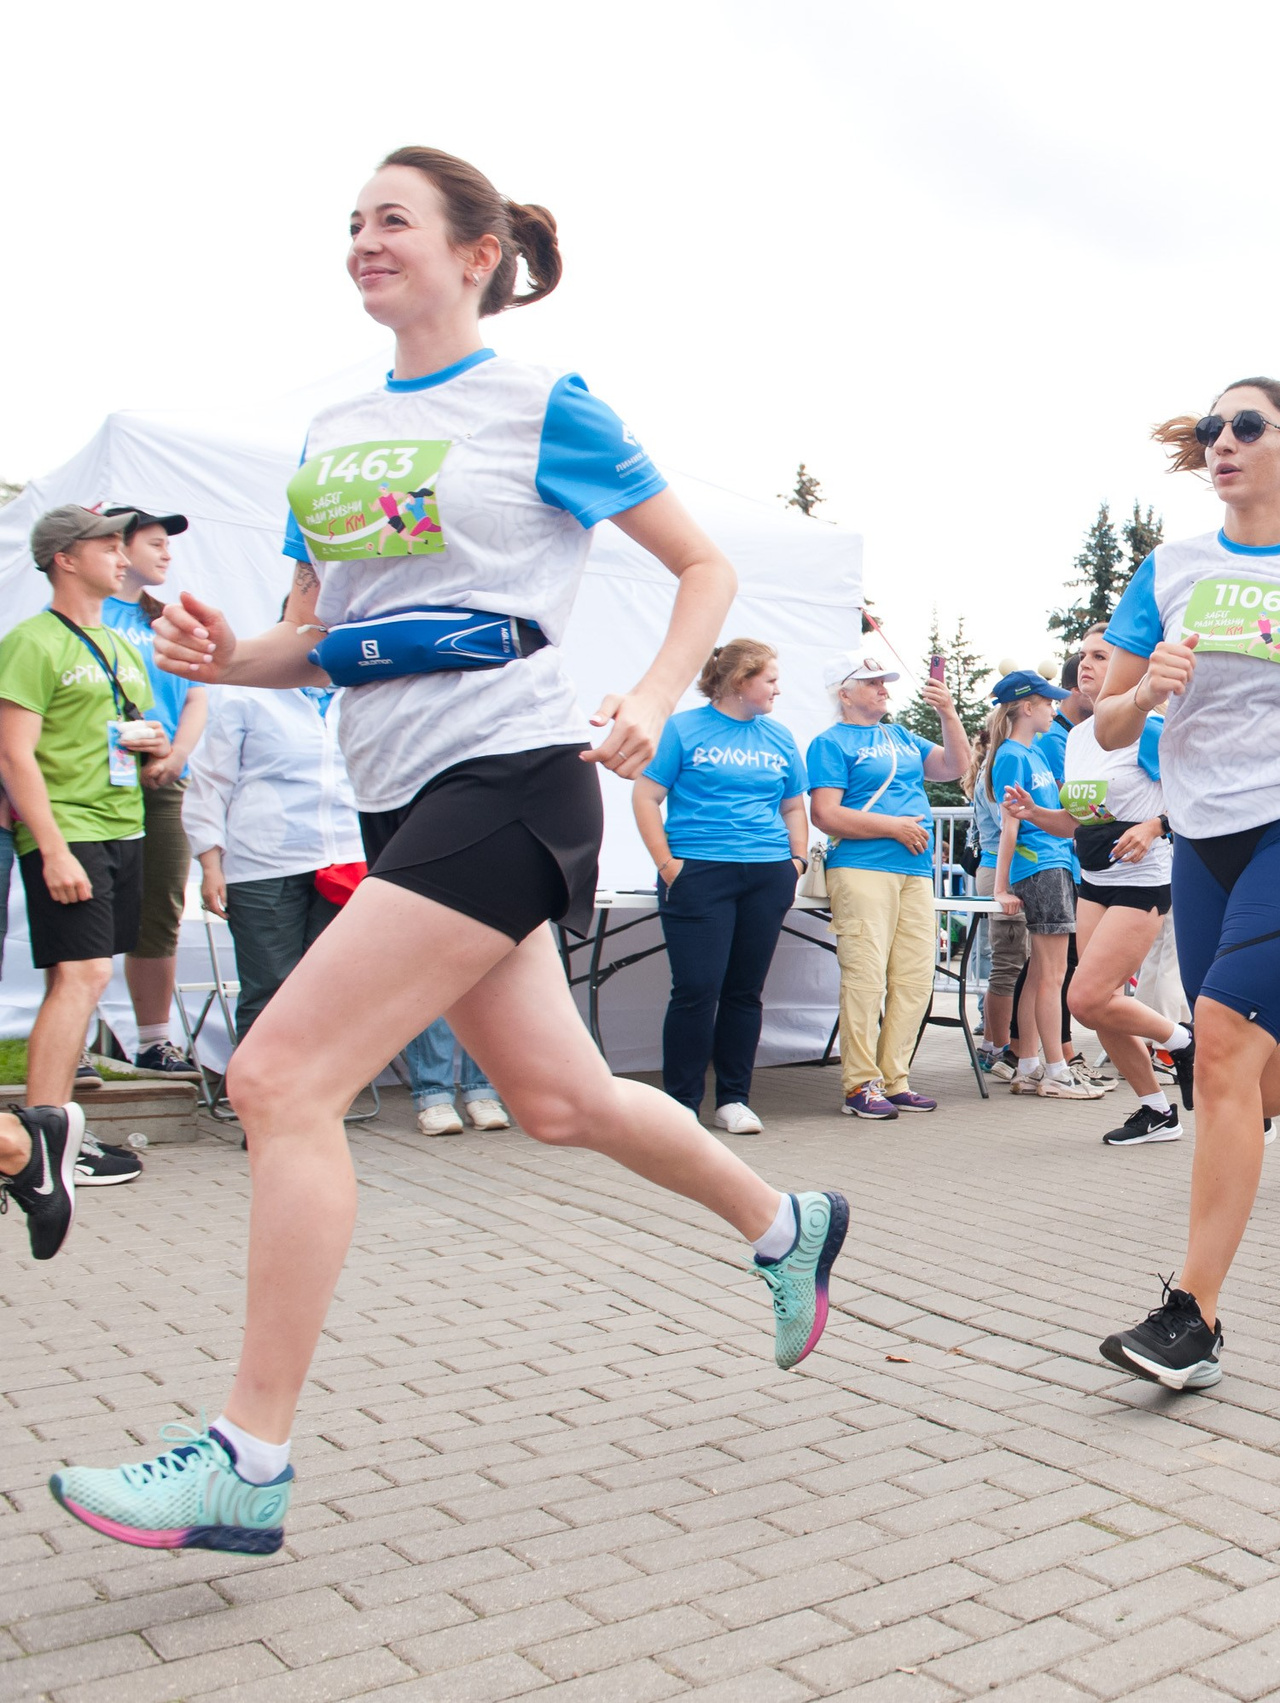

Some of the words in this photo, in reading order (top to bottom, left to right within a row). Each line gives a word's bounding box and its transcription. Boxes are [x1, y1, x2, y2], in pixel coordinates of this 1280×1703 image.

[316, 447, 419, 486] 1463
[312, 491, 343, 511] ЗАБЕГ
[305, 511, 327, 525] РАДИ
[328, 499, 363, 521] ЖИЗНИ
[1204, 610, 1231, 619] ЗАБЕГ
[1215, 618, 1245, 627] ЖИЗНИ
[1067, 783, 1097, 800] 1075
